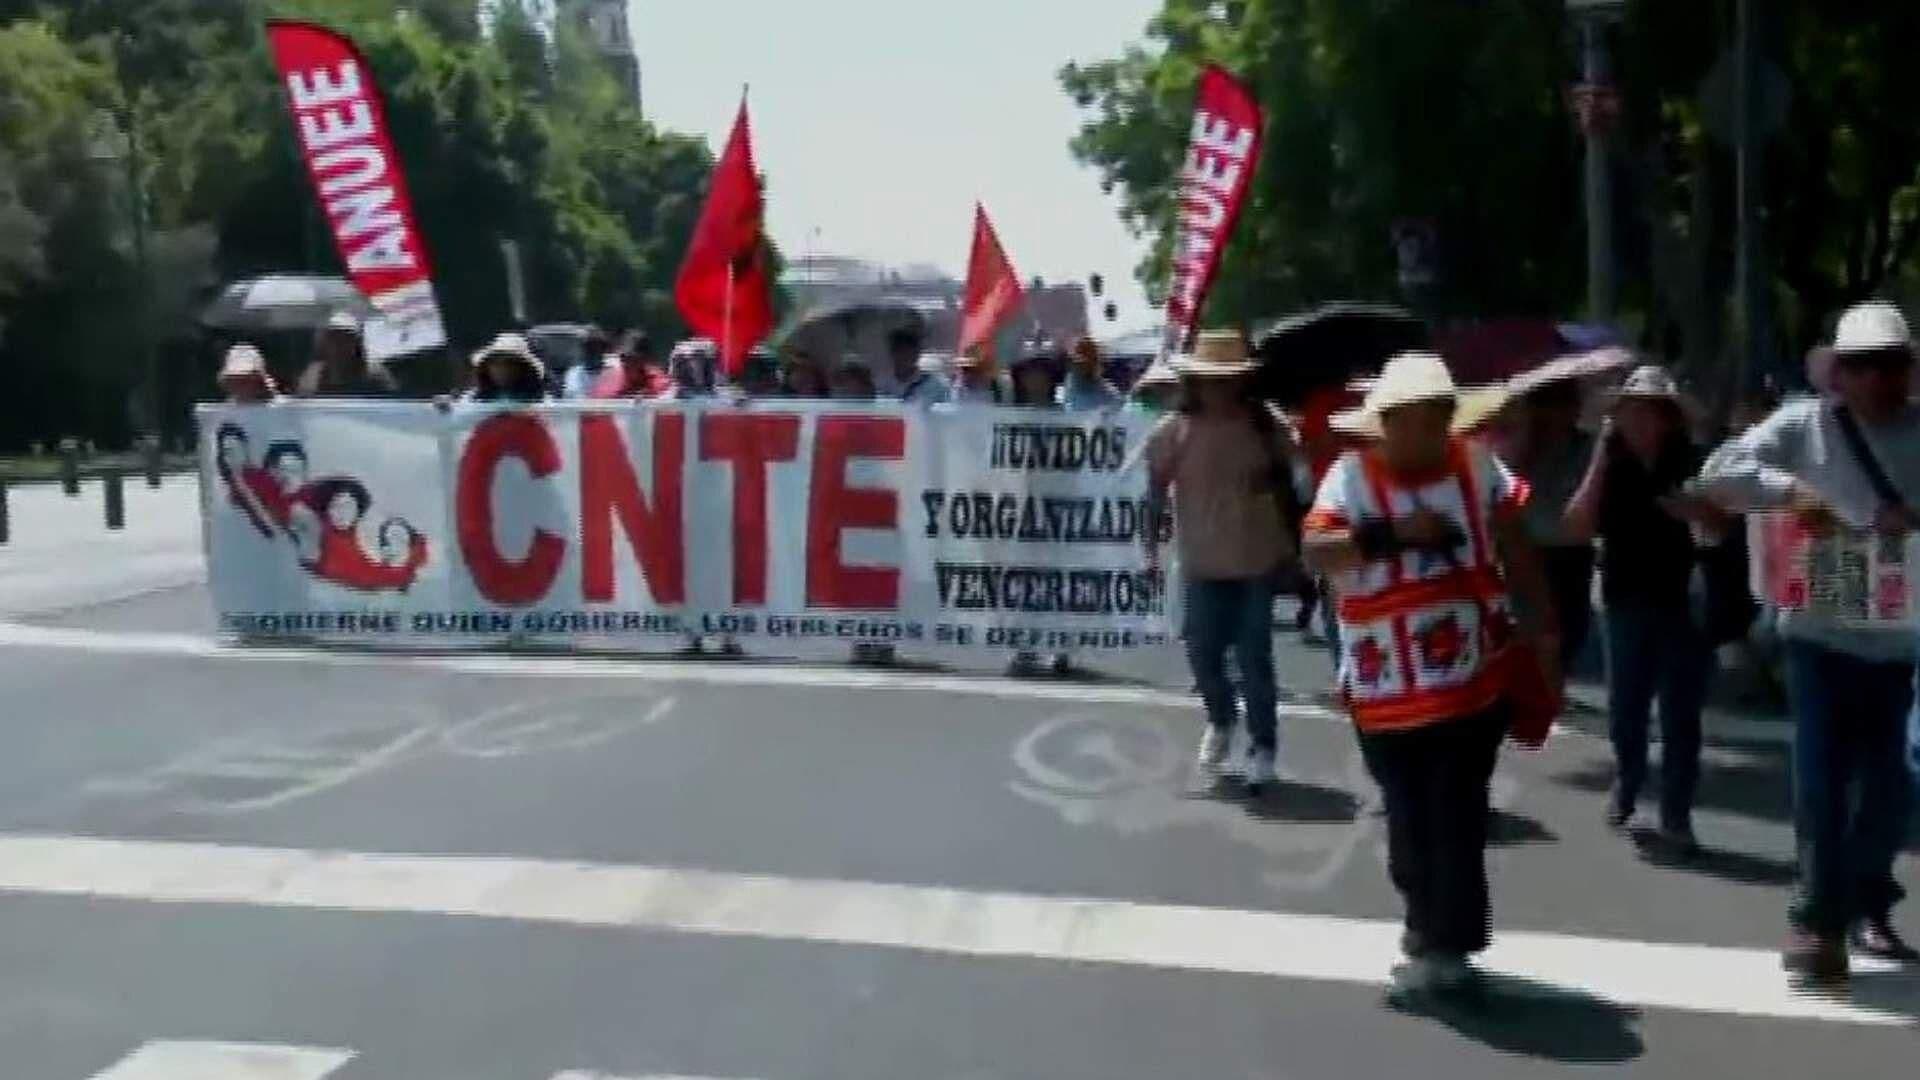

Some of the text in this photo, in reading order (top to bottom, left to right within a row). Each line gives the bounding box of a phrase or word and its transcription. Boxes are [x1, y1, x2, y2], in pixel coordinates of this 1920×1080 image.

[287, 58, 416, 273] ANUEE
[455, 411, 906, 609] CNTE
[922, 489, 946, 538] Y
